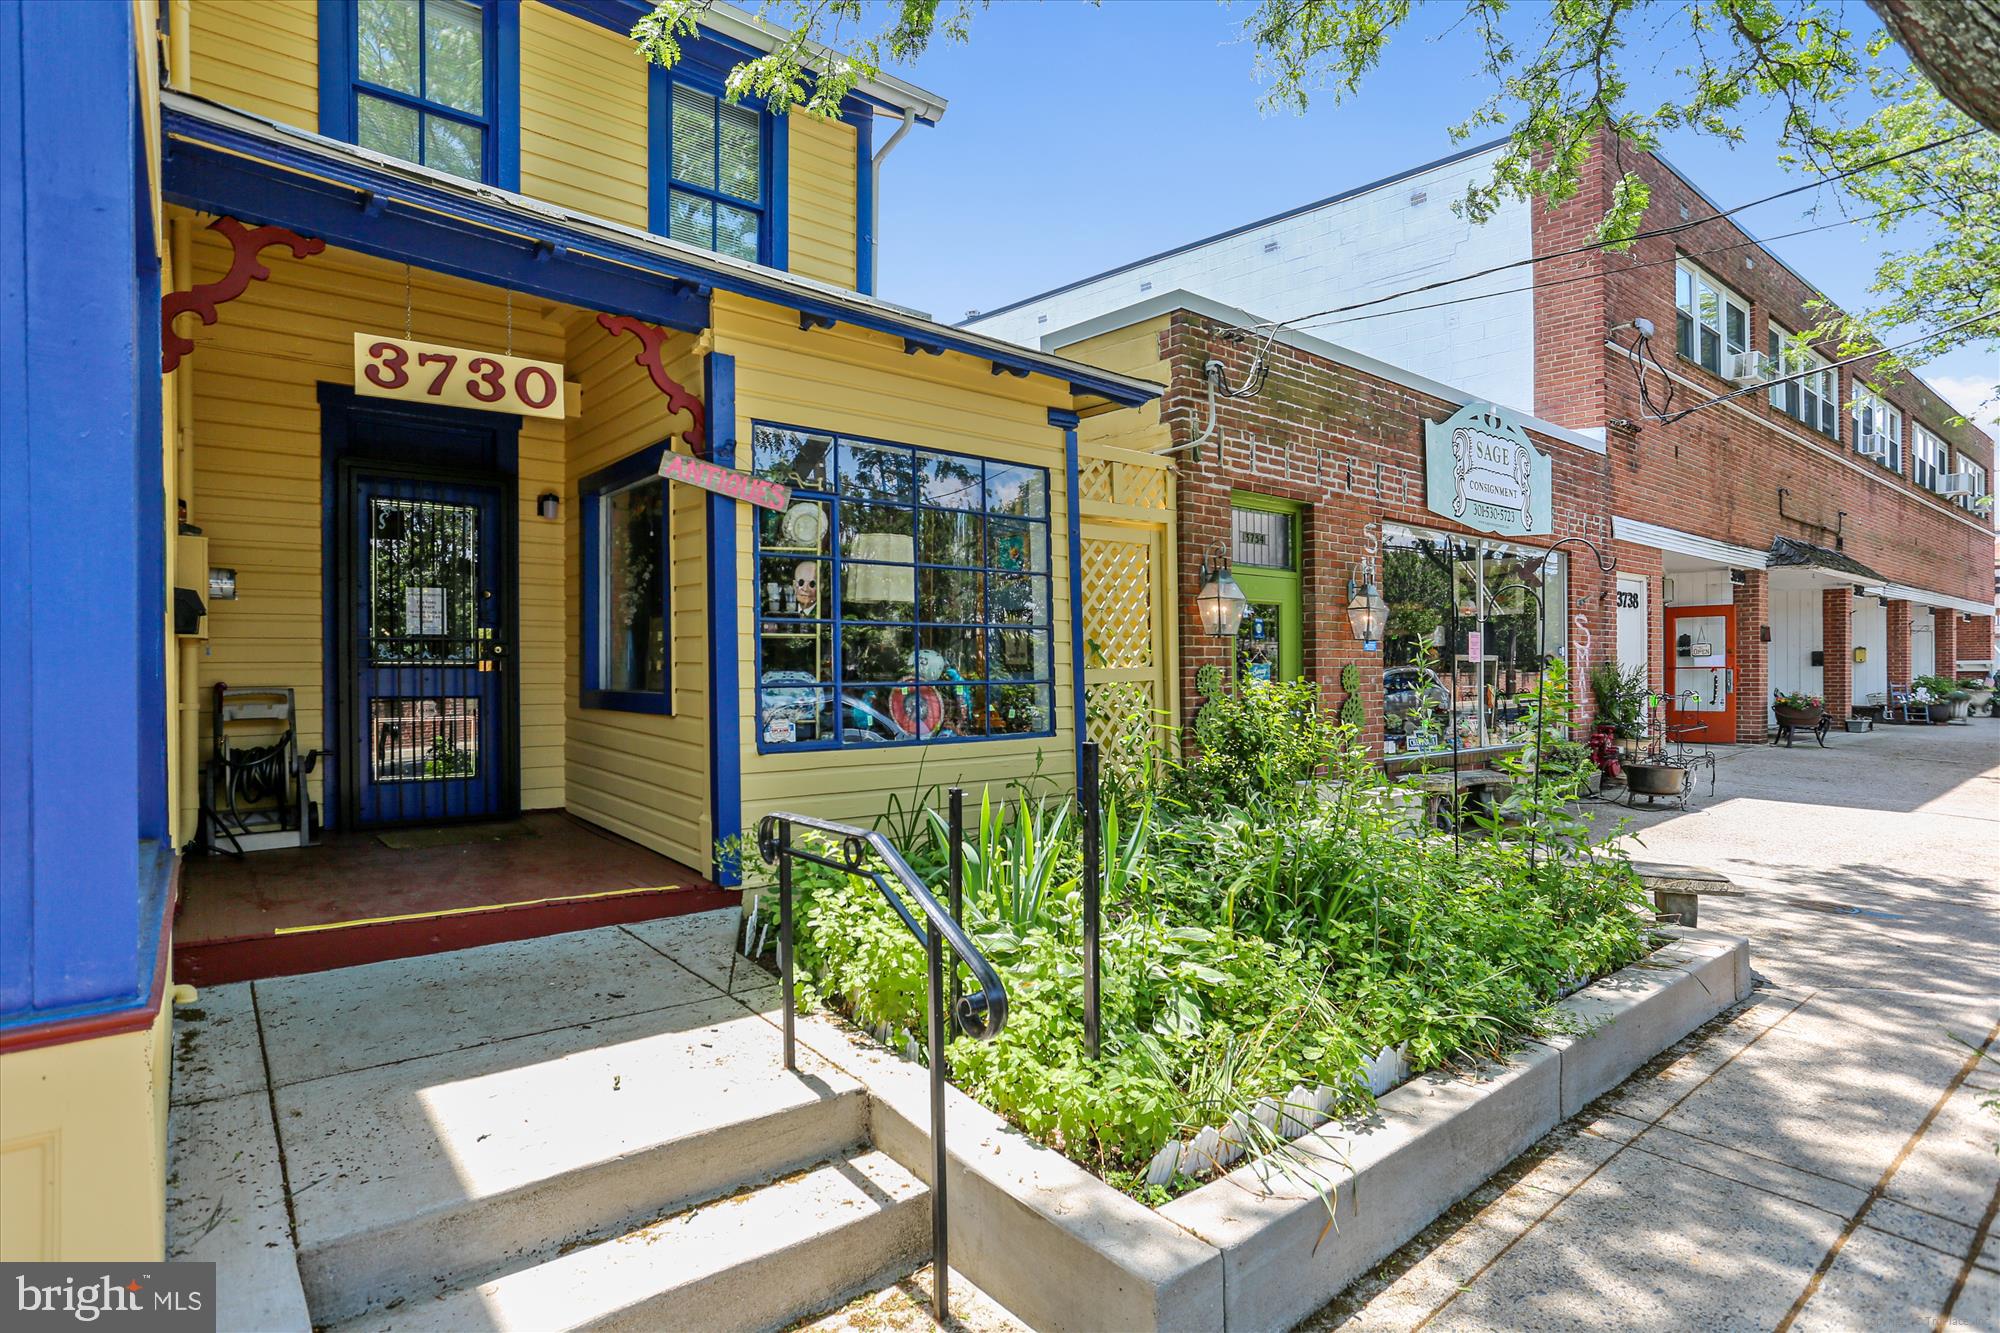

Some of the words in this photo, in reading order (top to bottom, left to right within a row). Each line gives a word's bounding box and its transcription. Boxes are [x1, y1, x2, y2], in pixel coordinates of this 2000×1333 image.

[364, 342, 557, 409] 3730
[1476, 440, 1510, 466] SAGE
[665, 456, 785, 509] ANTIQUES
[1469, 480, 1517, 499] CONSIGNMENT
[1473, 503, 1515, 523] 301-530-5723
[1617, 590, 1639, 609] 3738
[1693, 647, 1710, 655] OPEN
